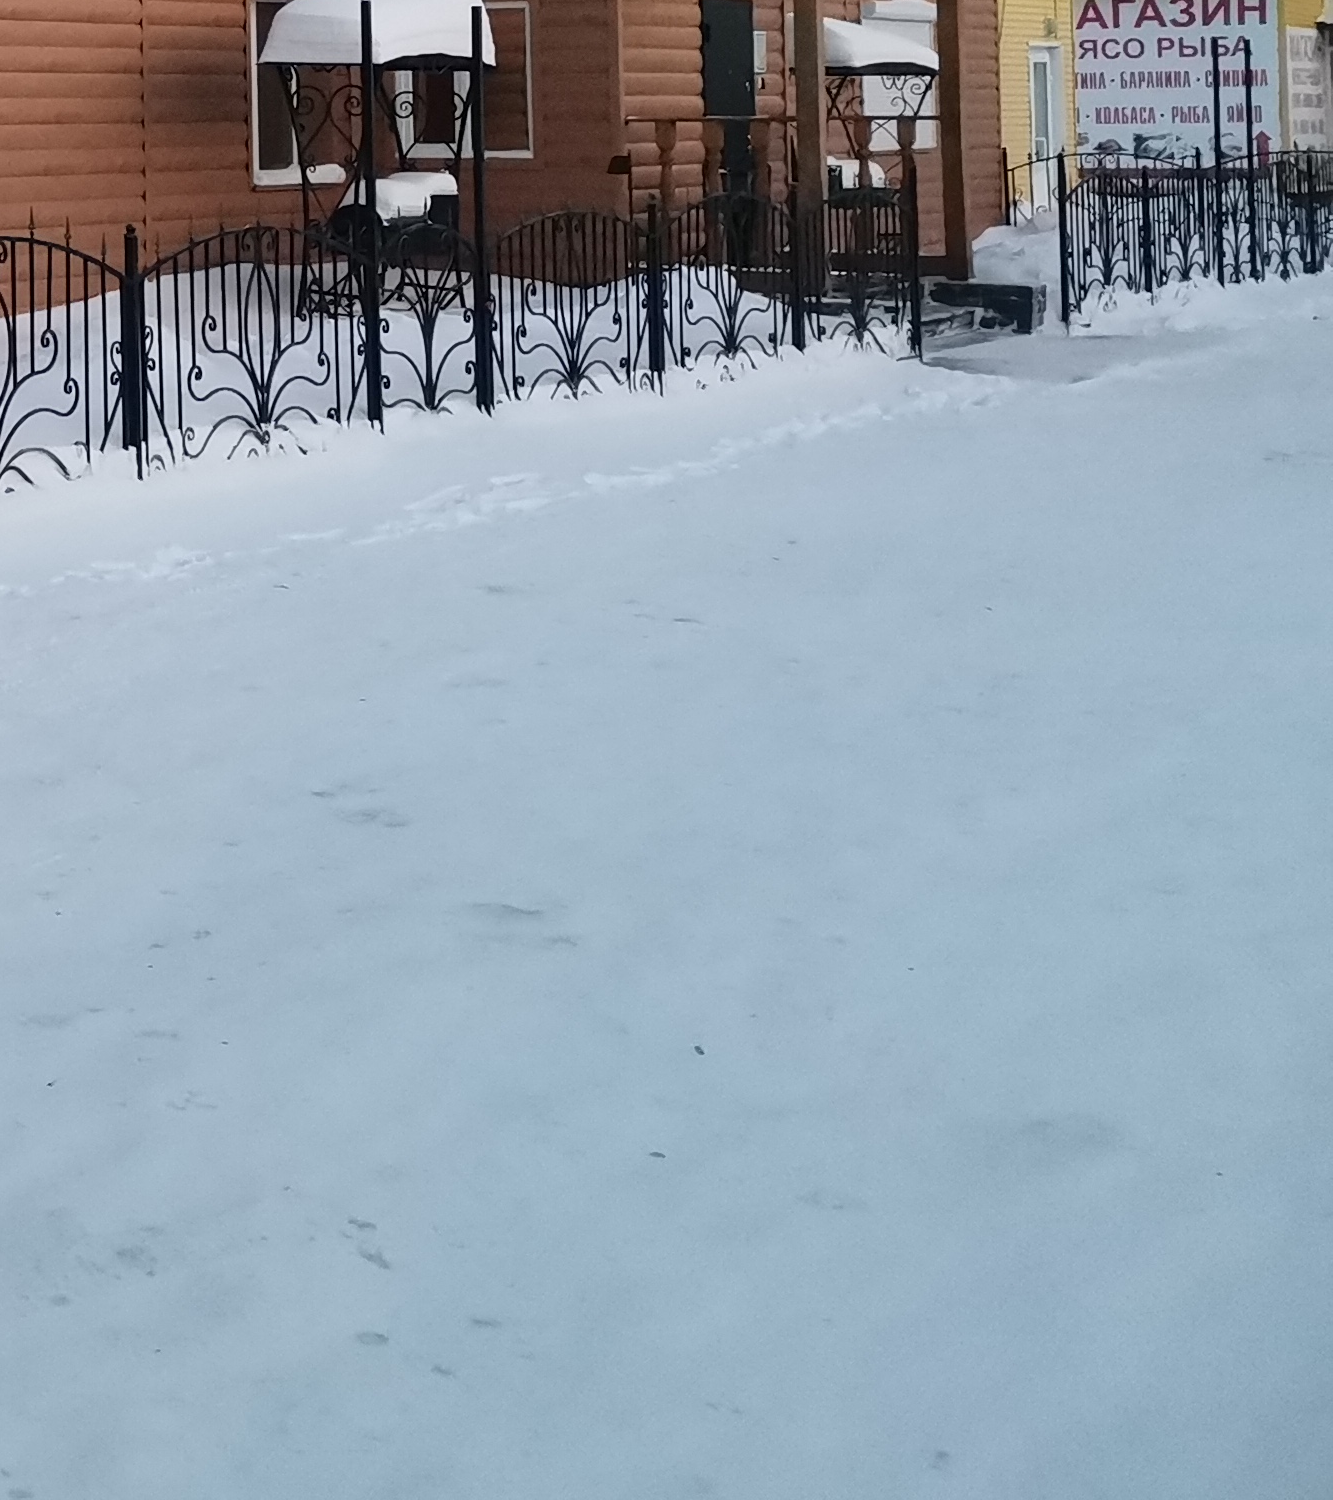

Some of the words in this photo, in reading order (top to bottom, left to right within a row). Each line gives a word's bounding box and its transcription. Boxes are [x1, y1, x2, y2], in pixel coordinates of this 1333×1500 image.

[1078, 37, 1145, 60] ЯСО
[1157, 35, 1253, 59] РЫБА
[1119, 70, 1192, 89] БАРАНИНА
[1204, 69, 1269, 88] СИНИНА
[1094, 106, 1156, 125] КОЛБАСА
[1171, 105, 1211, 124] РЫБА
[1226, 102, 1263, 124] ЯЙО
